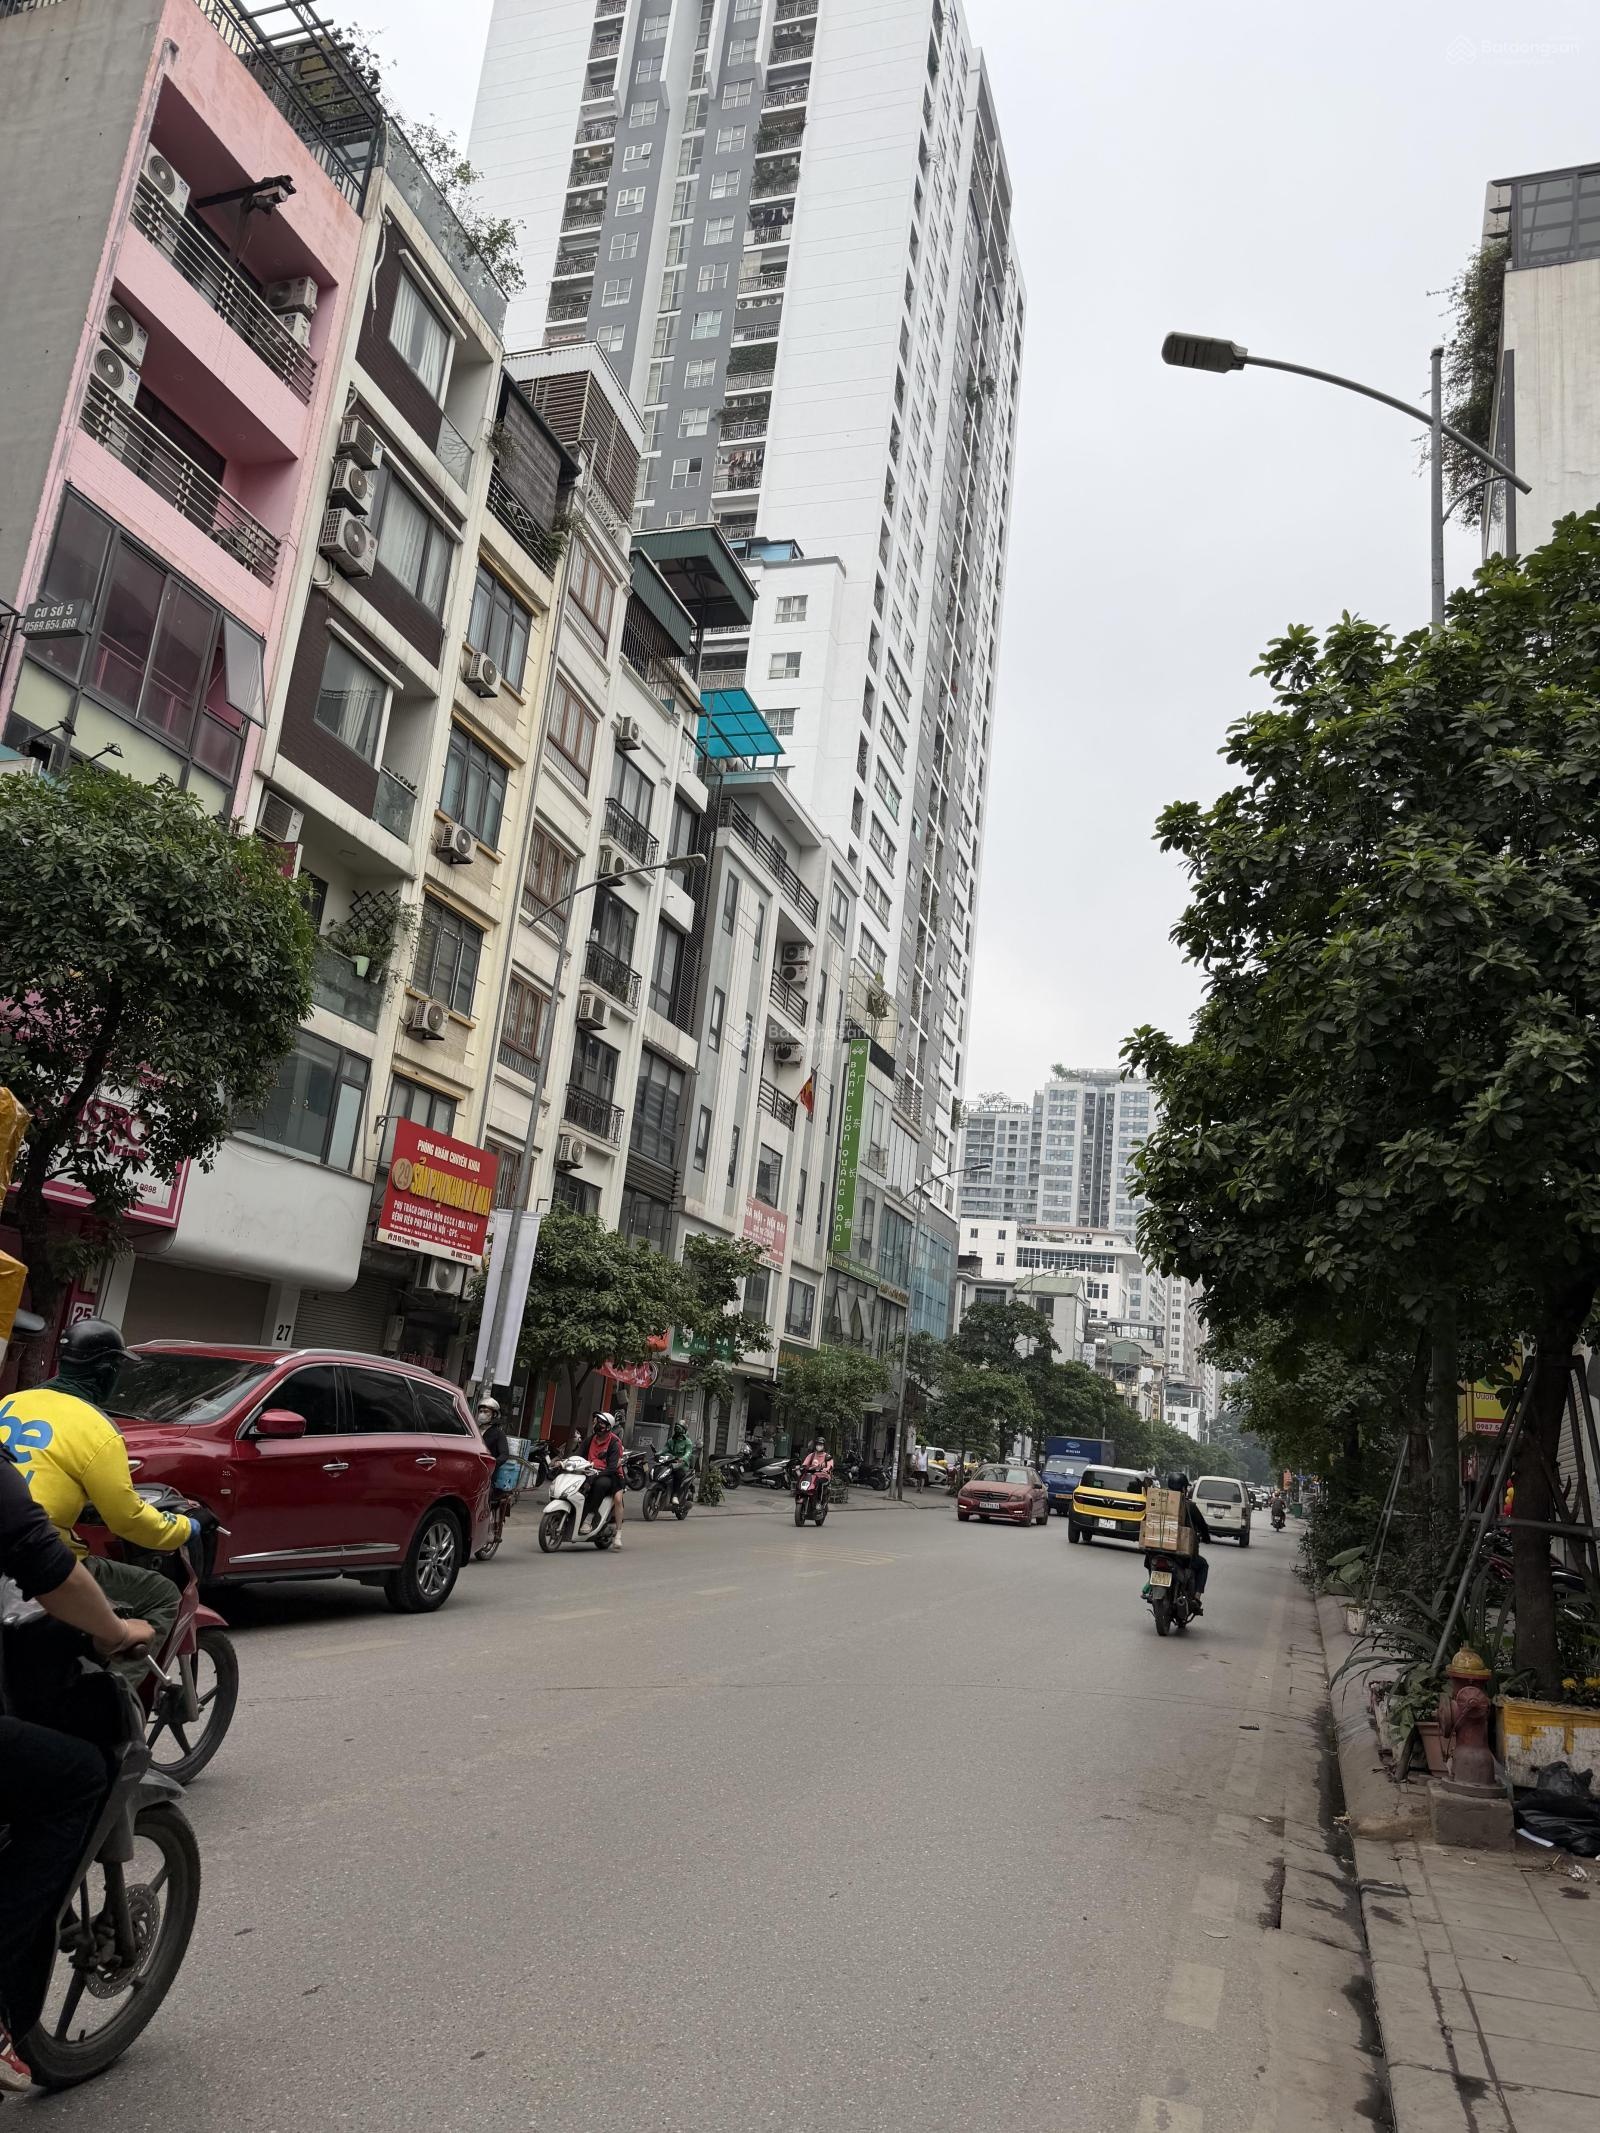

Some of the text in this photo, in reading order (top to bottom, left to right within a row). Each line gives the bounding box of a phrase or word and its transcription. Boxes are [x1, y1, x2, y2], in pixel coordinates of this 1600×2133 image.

[34, 603, 74, 618] CƠ SỞ 5
[73, 1306, 92, 1324] 25
[276, 1324, 291, 1342] 27
